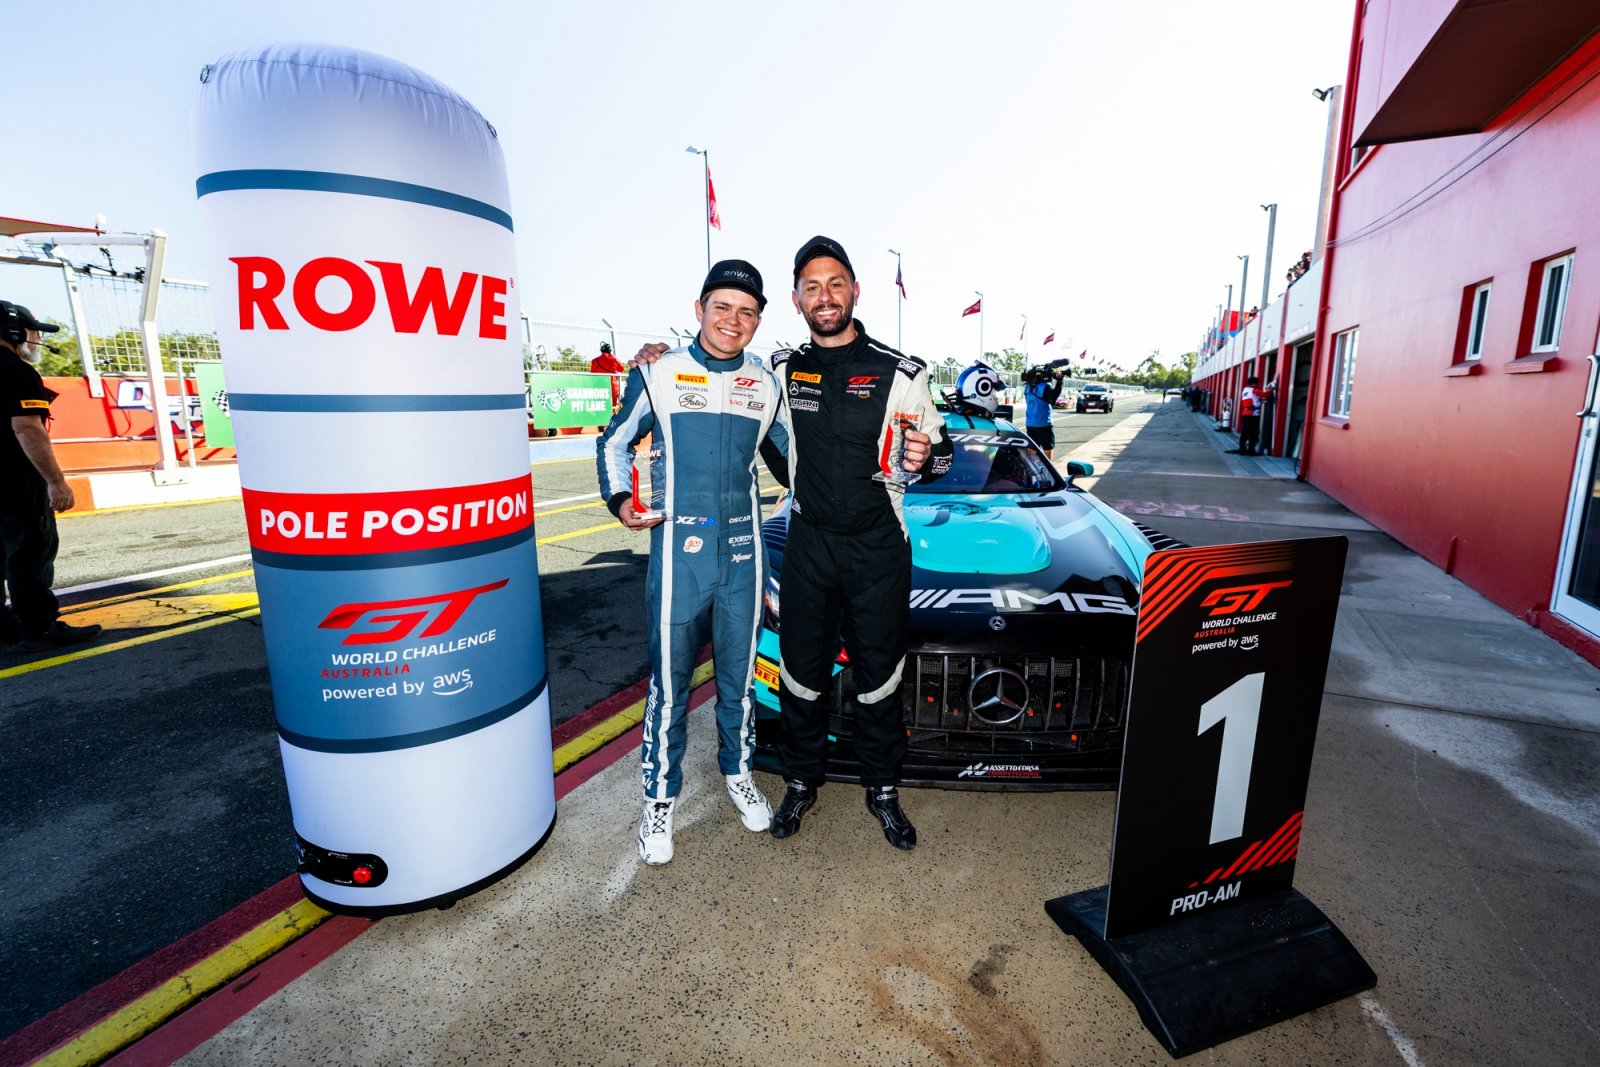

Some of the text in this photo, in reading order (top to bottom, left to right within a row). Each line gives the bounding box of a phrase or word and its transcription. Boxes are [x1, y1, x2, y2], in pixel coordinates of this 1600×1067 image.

[228, 256, 508, 341] ROWE
[571, 401, 584, 412] PIT
[260, 491, 527, 539] POLE POSITION
[317, 578, 510, 645] GT
[1200, 580, 1294, 616] GT
[1194, 627, 1236, 639] AUSTRALIA
[1202, 612, 1277, 629] WORLD CHALLENGE
[331, 629, 497, 666] WORLD CHALLENGE
[1191, 634, 1259, 654] powered by aws
[321, 664, 411, 679] AUSTRALIA
[322, 668, 473, 702] powered by aws
[1197, 671, 1265, 845] 1
[1169, 880, 1242, 916] PRO-AM
